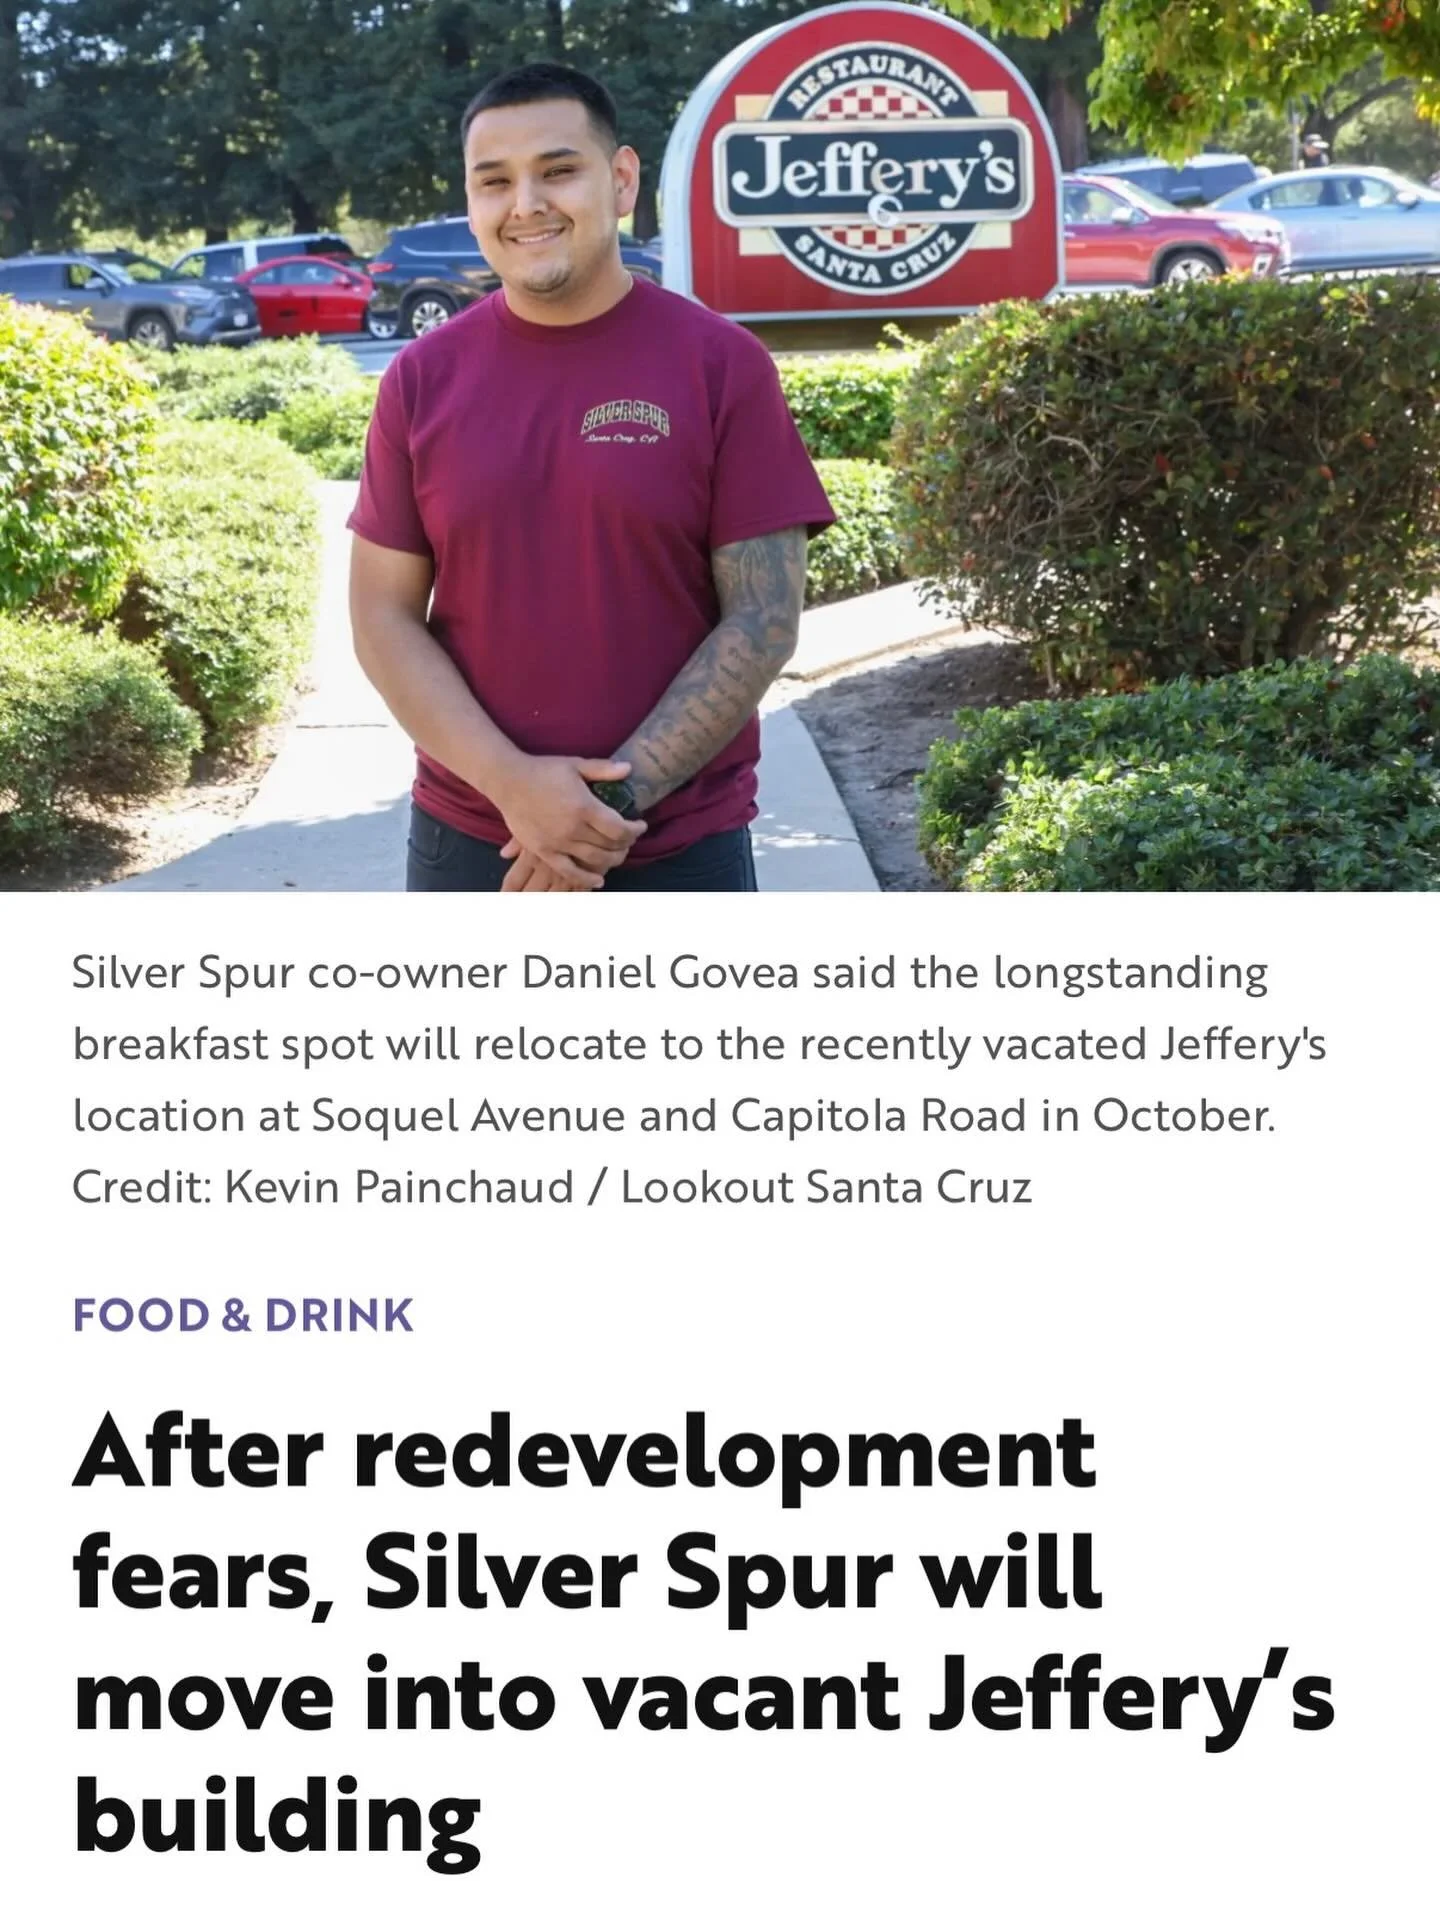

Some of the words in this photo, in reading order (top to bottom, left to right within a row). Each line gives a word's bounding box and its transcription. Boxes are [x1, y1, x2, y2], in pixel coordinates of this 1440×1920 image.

[786, 54, 960, 112] RESTAURANT
[794, 233, 881, 284] SANTA
[890, 231, 957, 280] CRUZ
[581, 400, 632, 435] SILVER
[632, 400, 670, 437] SPUR
